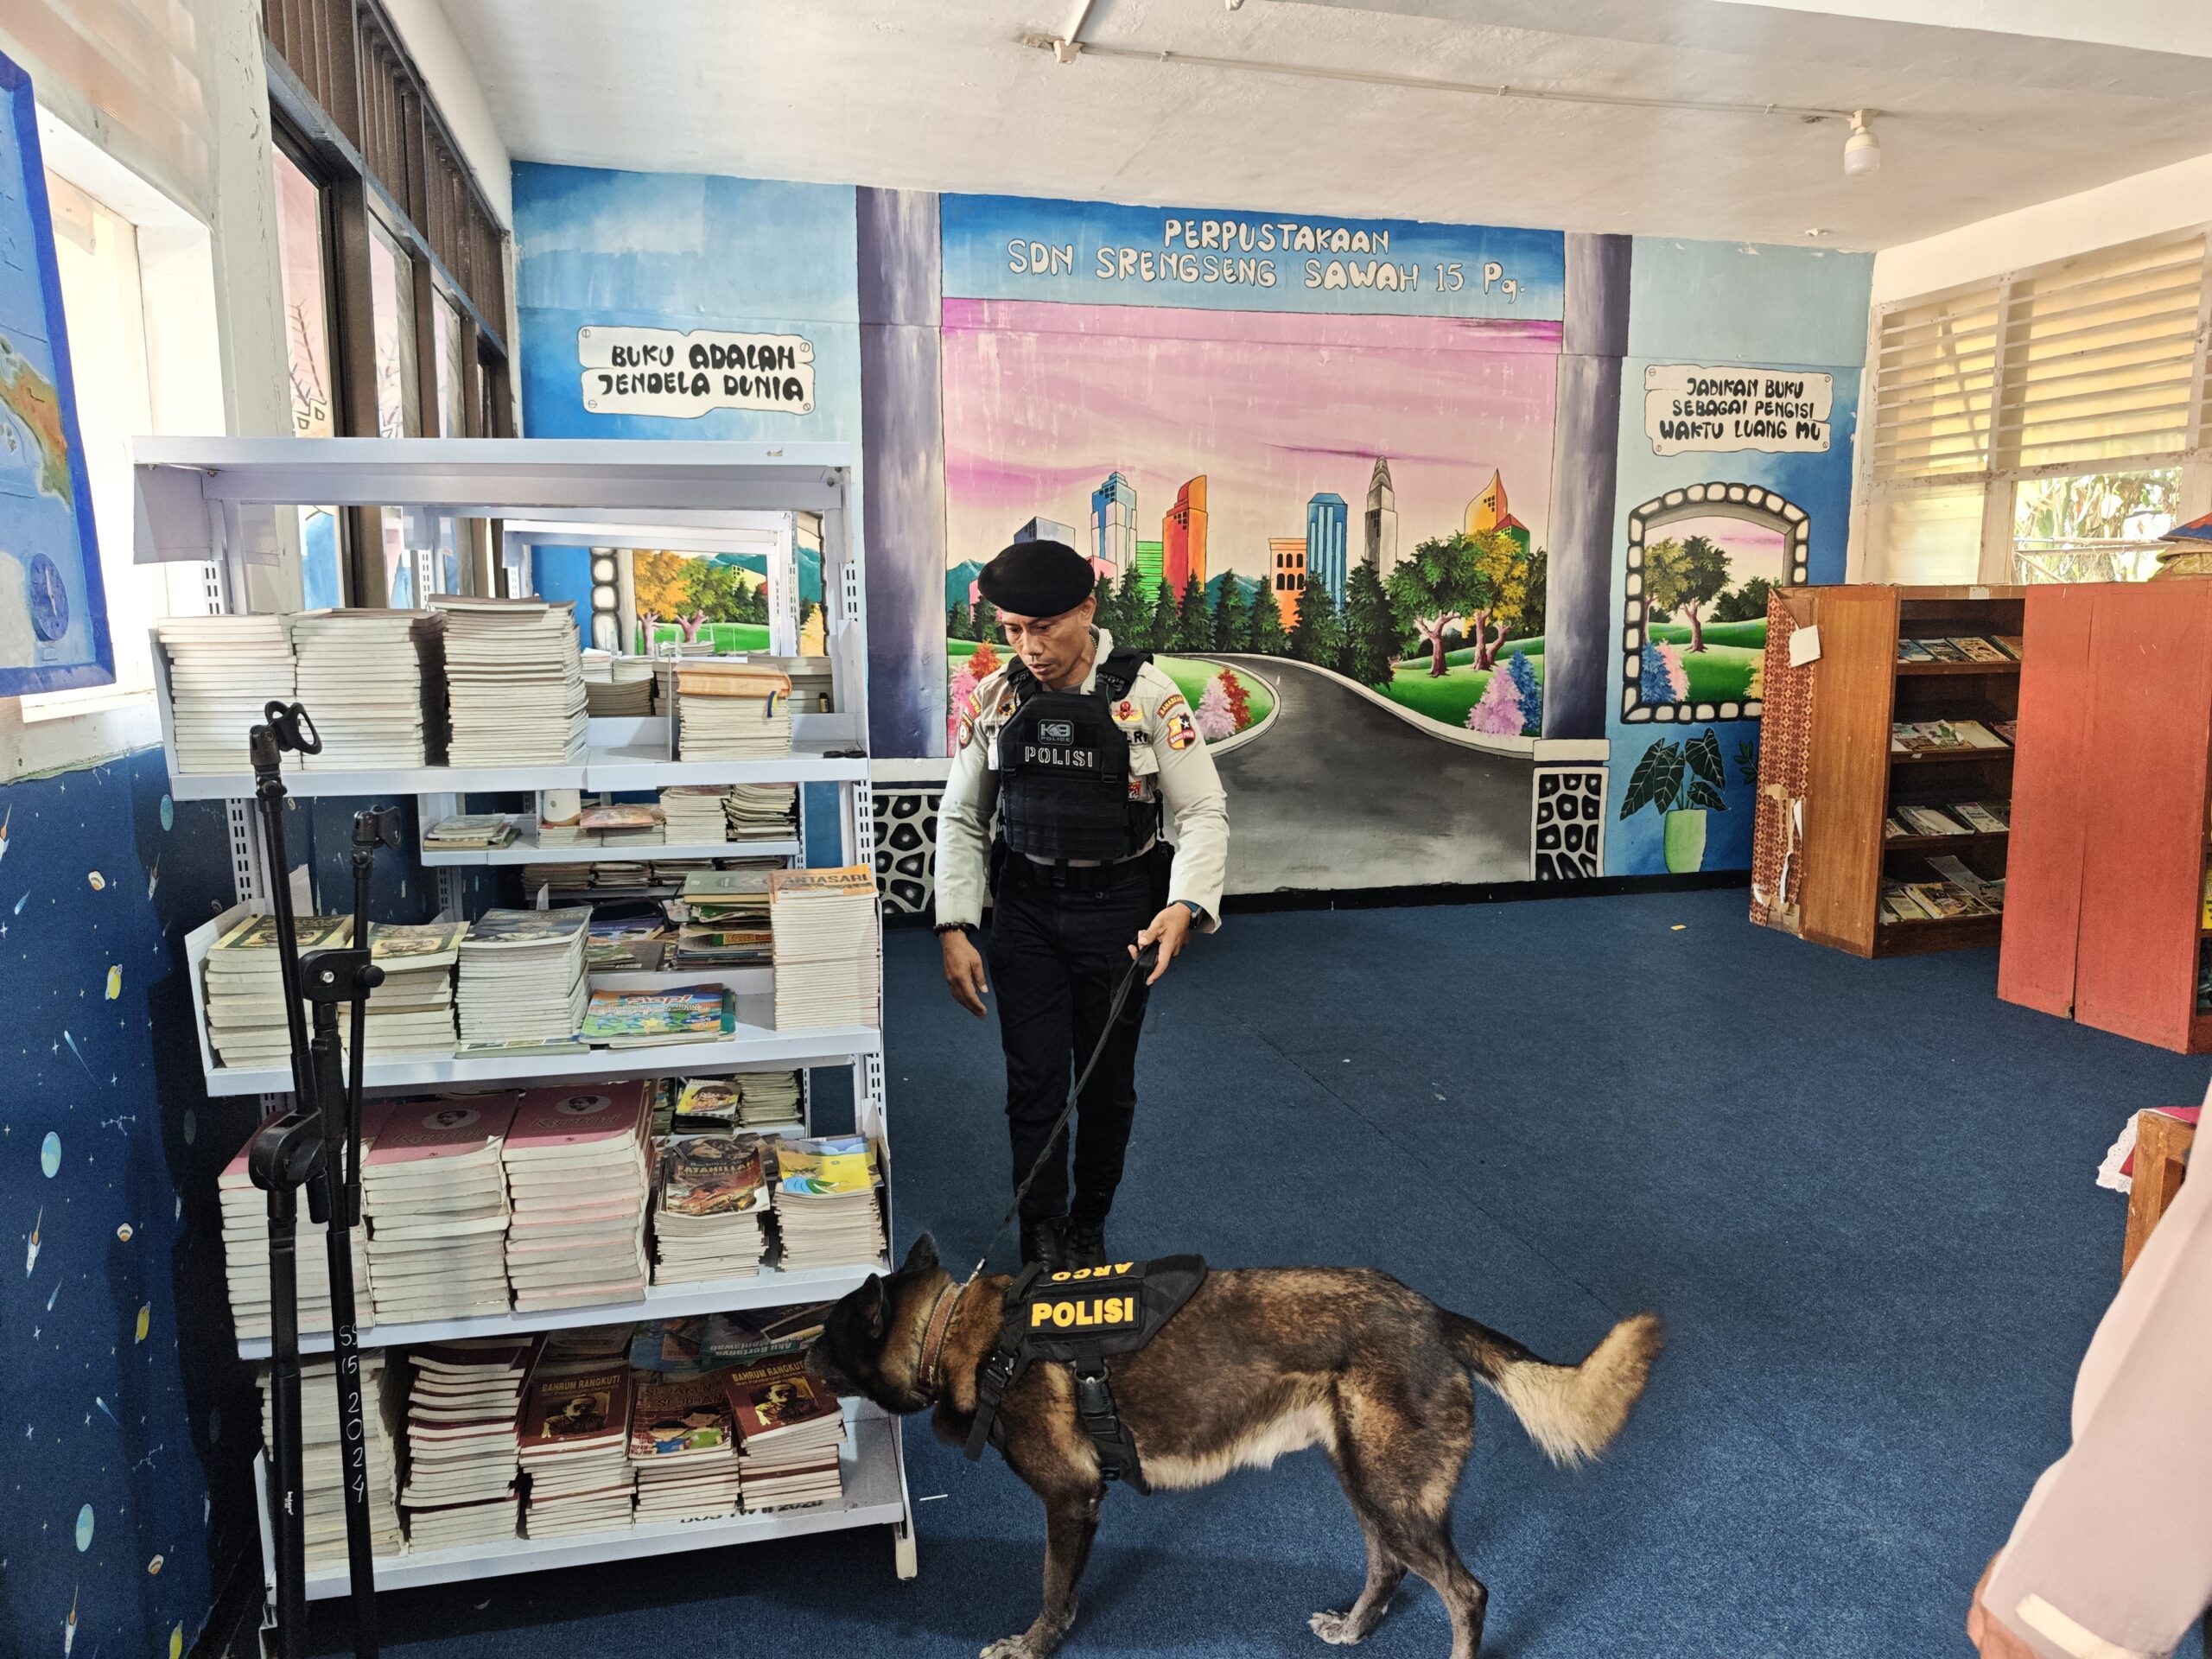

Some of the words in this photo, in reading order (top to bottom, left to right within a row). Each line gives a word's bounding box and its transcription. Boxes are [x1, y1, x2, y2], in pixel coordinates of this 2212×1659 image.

[1165, 219, 1390, 255] PERPUSTAKAAN
[1007, 238, 1074, 276] SDN
[1096, 246, 1277, 288] SRENGSENG
[1304, 258, 1420, 292] SAWAH
[1434, 263, 1465, 292] 15
[611, 344, 674, 367] BUKU
[689, 343, 796, 372] ADALAH
[598, 371, 711, 397] JENDELA
[723, 375, 804, 402] DUNIA
[1686, 378, 1758, 397] JADIKAN
[1764, 379, 1804, 399] BUKU
[1672, 399, 1747, 417] SEBAGAI
[1755, 401, 1815, 419] PENGISI
[1659, 420, 1724, 441] WAKTU
[1734, 420, 1787, 439] LUANG
[1796, 421, 1821, 441] MU
[1040, 723, 1071, 737] K9
[1025, 746, 1093, 767] POLISI
[1052, 1262, 1135, 1281] ARCO
[1031, 1297, 1134, 1327] POLISI
[732, 1369, 767, 1382] BAHRUM
[766, 1360, 805, 1376] RANGKUT
[542, 1378, 578, 1392] BAHRUM
[578, 1375, 620, 1389] RANGKUTI
